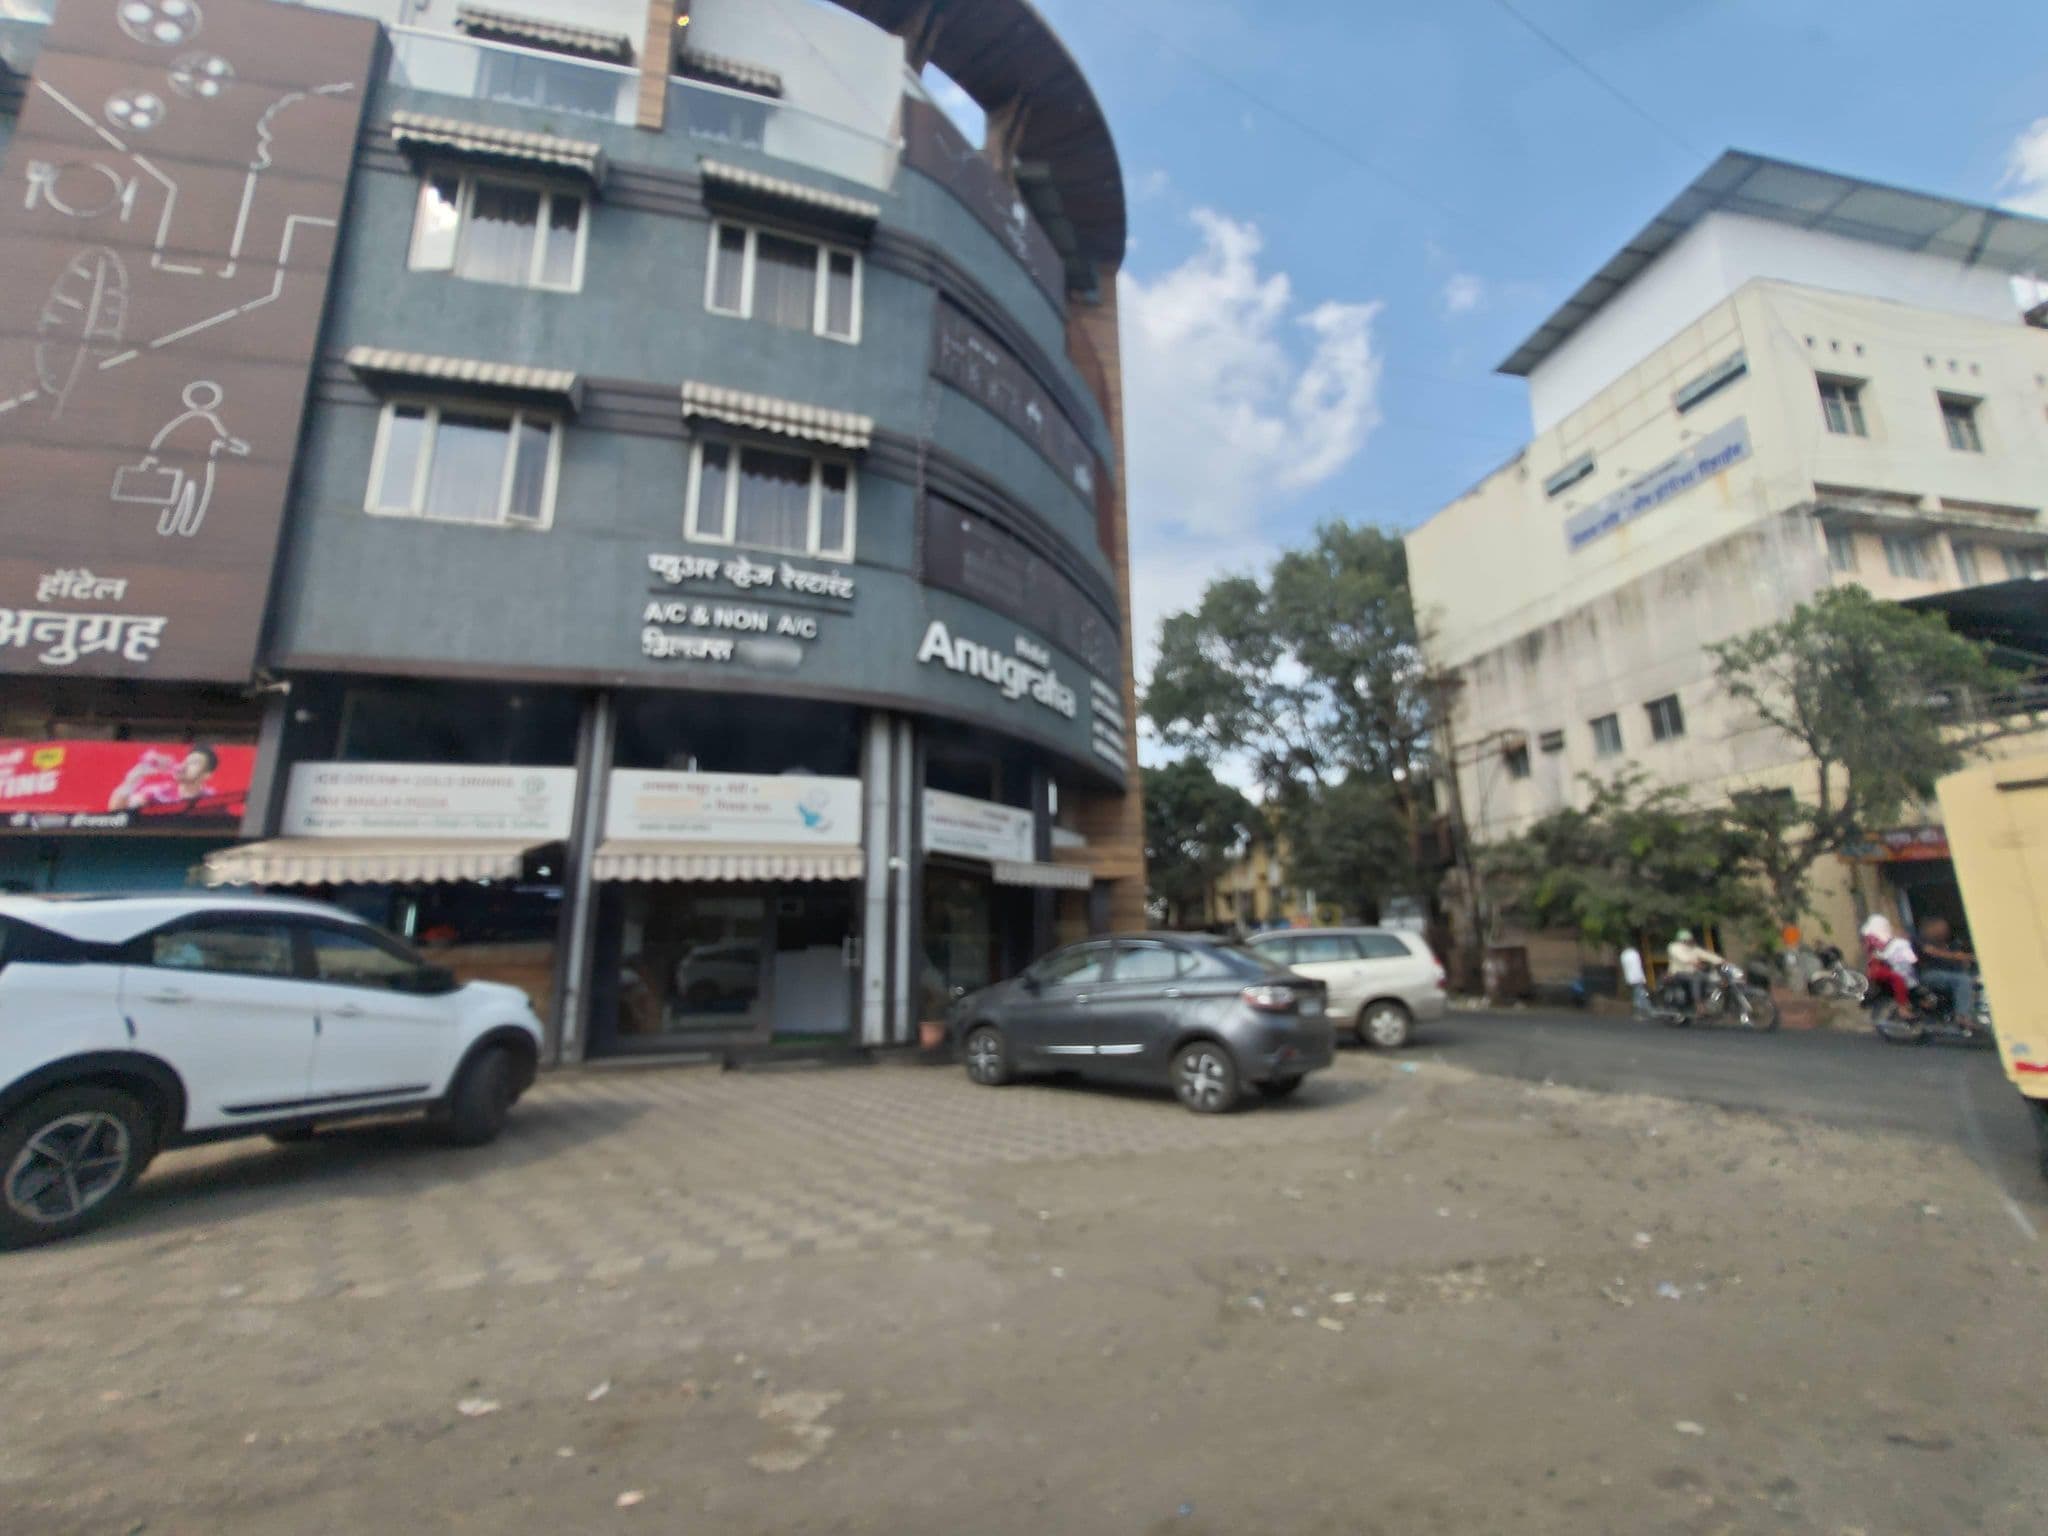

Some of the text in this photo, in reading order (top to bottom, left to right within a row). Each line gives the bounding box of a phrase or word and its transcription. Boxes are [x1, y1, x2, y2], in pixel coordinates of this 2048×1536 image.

[36, 567, 128, 602] हॉटेल
[0, 608, 168, 665] अनुग्रह
[643, 601, 818, 639] A/C & NON A/C
